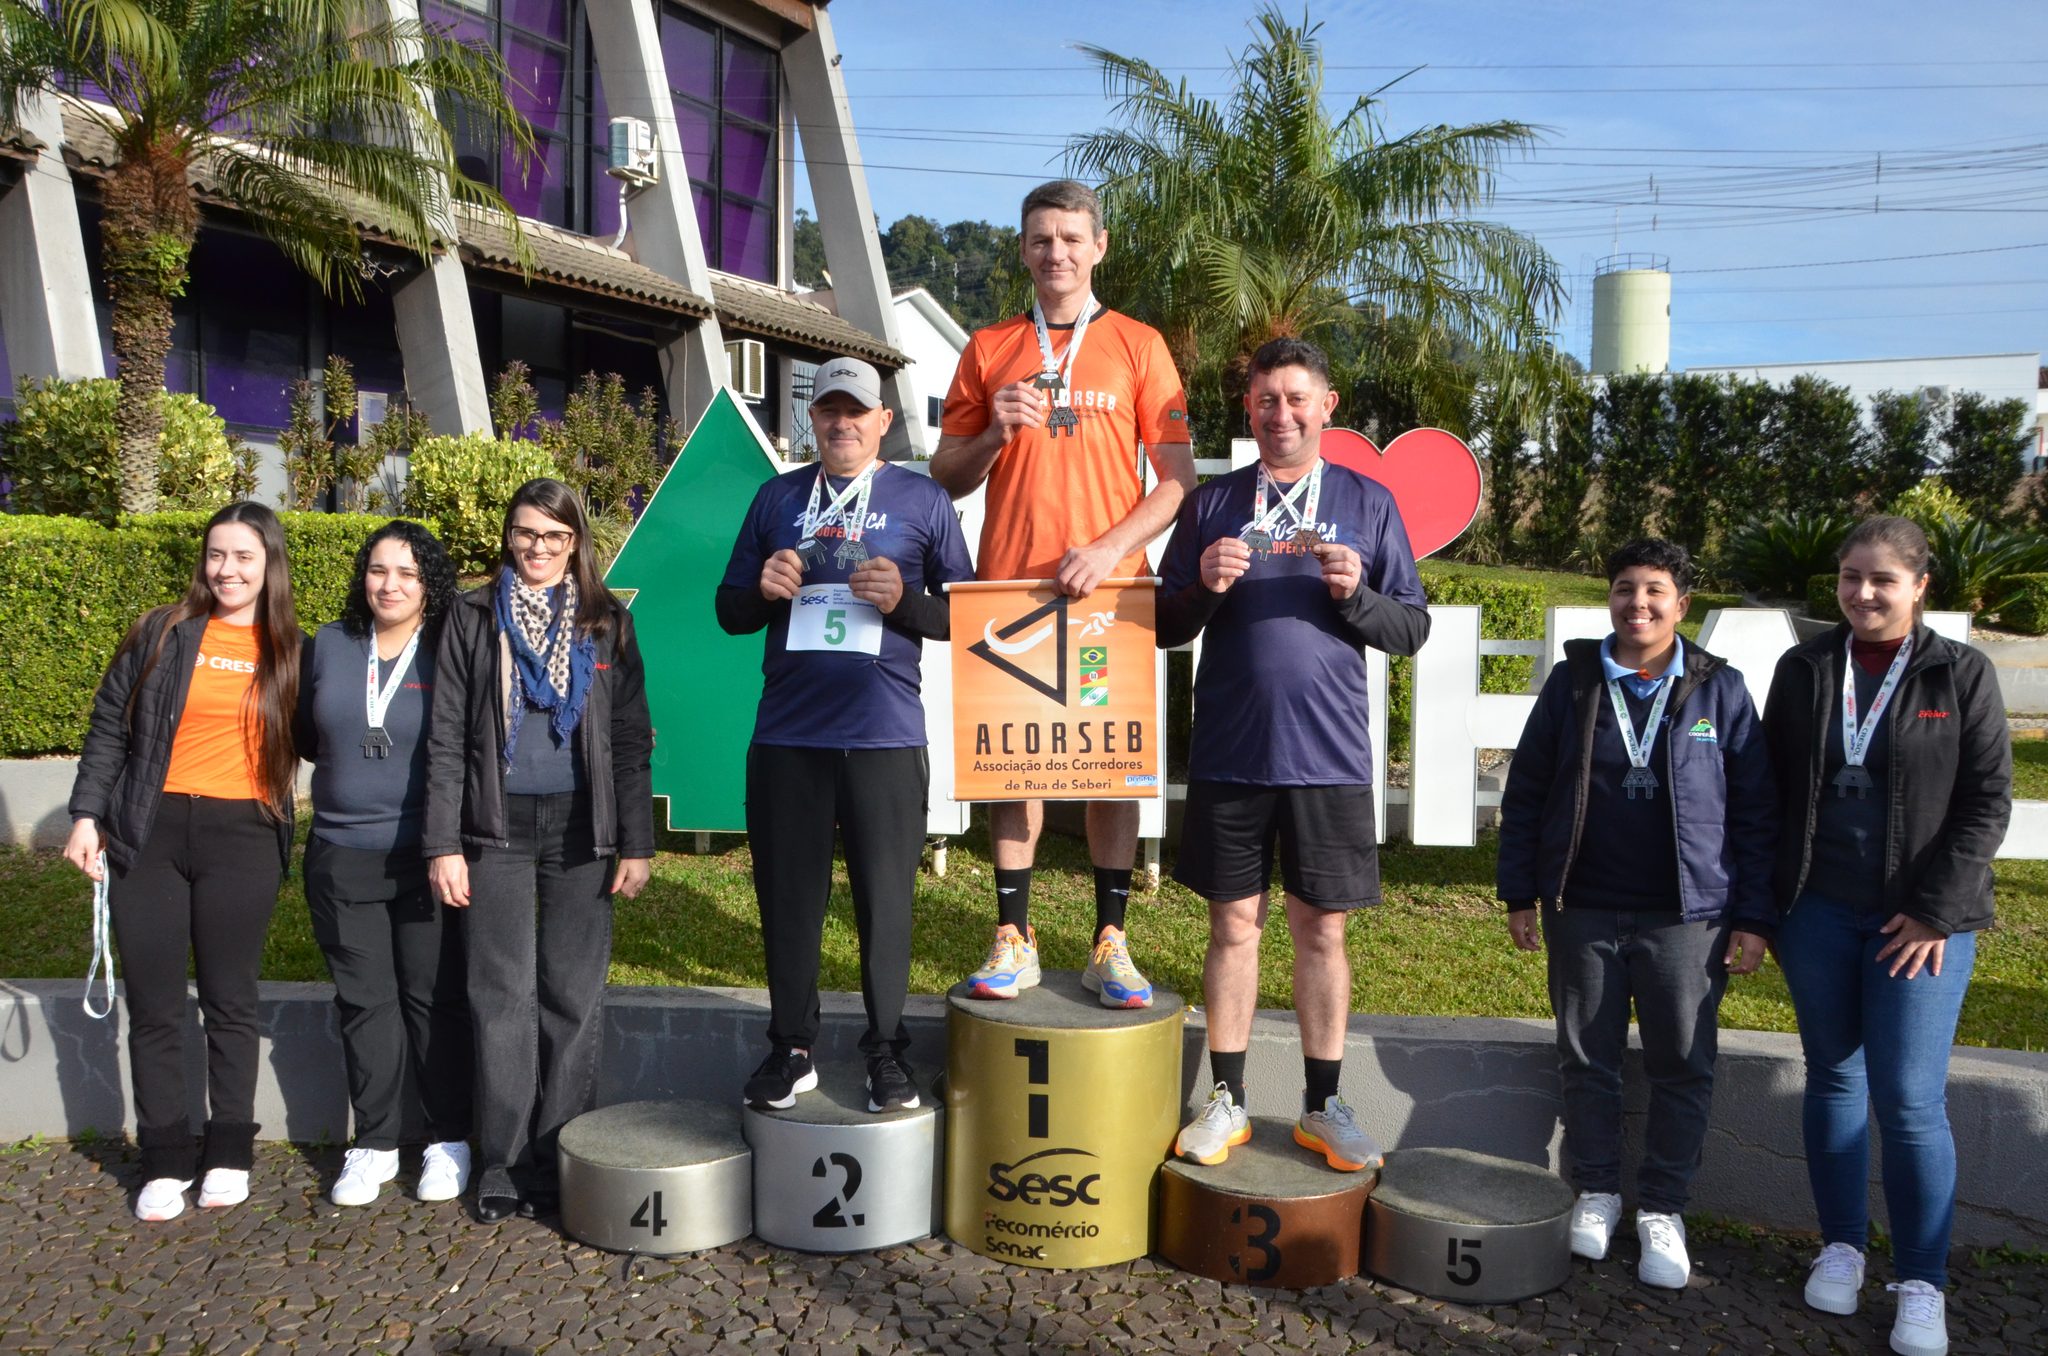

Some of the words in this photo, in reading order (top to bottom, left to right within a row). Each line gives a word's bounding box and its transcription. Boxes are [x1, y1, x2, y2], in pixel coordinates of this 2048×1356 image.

[824, 609, 847, 646] 5
[209, 656, 257, 674] CRES
[975, 720, 1144, 756] ACORSEB
[973, 759, 1042, 775] Associação
[1045, 758, 1068, 772] dos
[1071, 757, 1143, 771] Corredores
[1004, 779, 1020, 791] de
[1024, 780, 1048, 791] Rua
[1051, 778, 1068, 791] de
[1071, 778, 1112, 791] Seberi
[1014, 1038, 1049, 1138] 1
[812, 1152, 865, 1228] 2
[630, 1190, 667, 1236] 4
[1230, 1204, 1282, 1281] 3
[1446, 1237, 1482, 1286] 5
